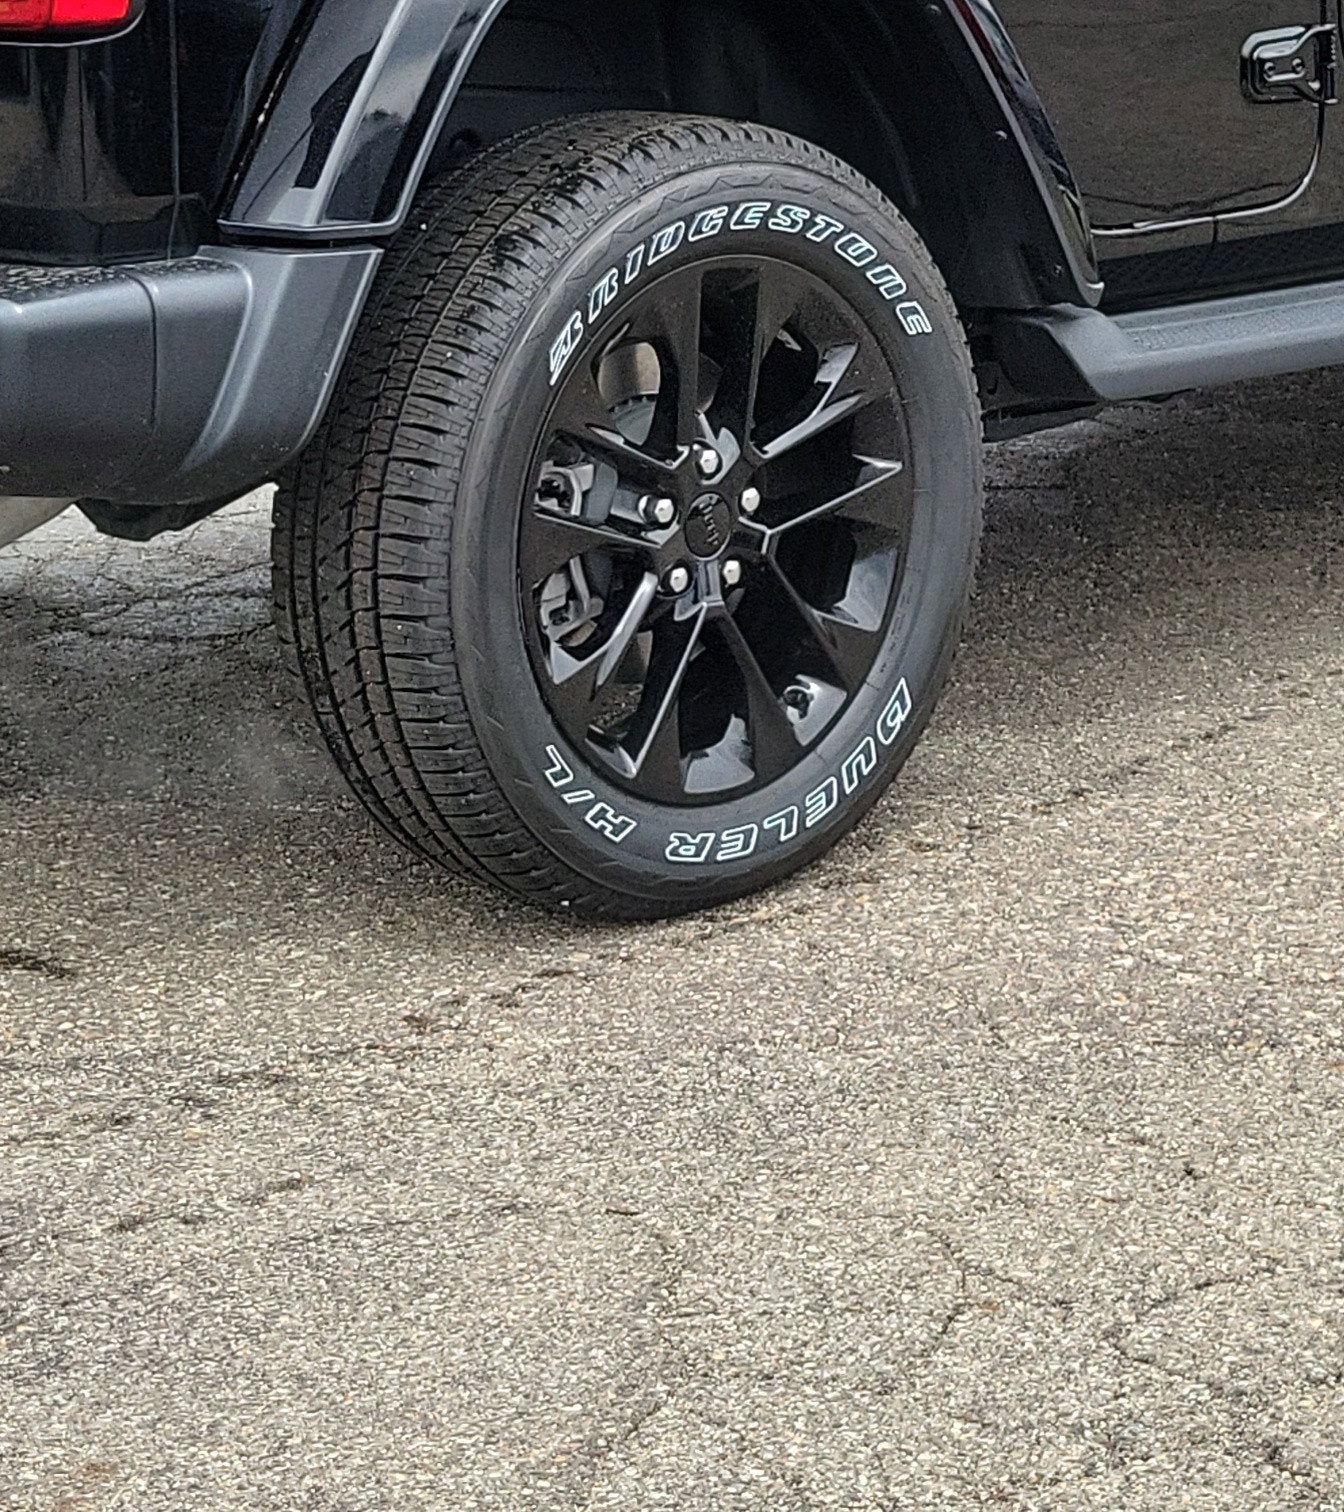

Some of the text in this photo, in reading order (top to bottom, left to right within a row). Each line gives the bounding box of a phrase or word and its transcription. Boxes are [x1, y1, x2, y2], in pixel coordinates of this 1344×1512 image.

[548, 200, 933, 387] BRIDGESTONE
[543, 676, 913, 863] DUELER H/L
